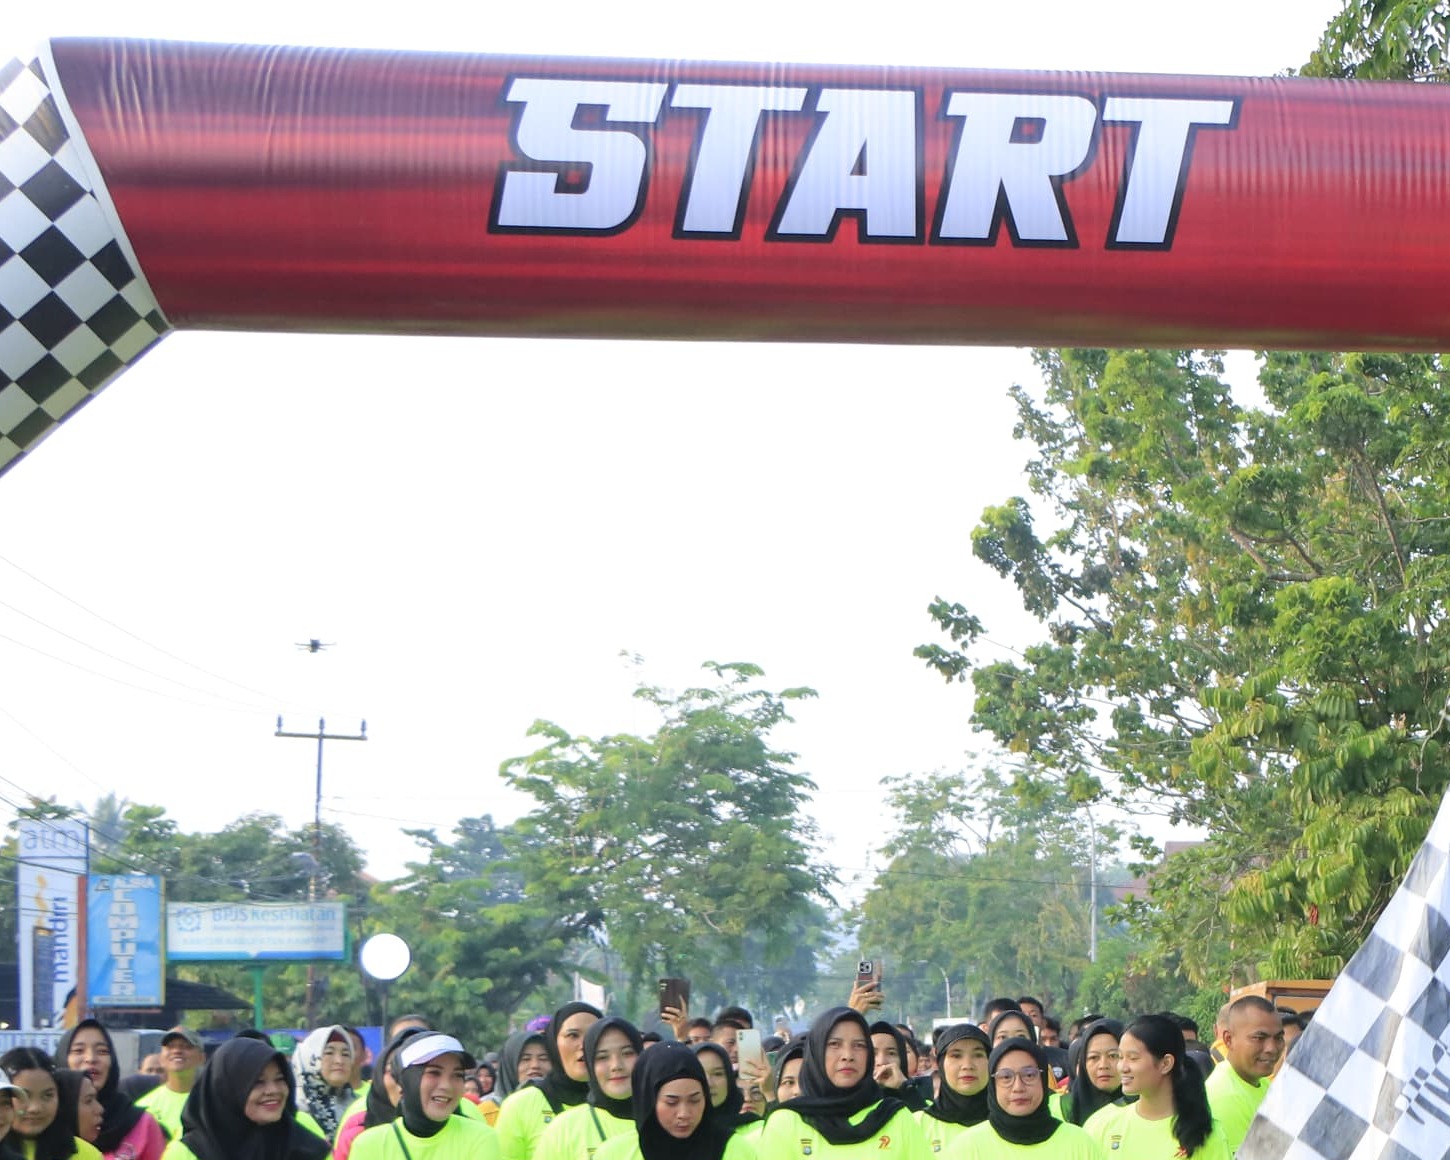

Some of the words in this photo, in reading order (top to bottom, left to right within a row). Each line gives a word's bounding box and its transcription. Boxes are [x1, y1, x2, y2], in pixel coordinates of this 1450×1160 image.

[490, 75, 1241, 249] START
[24, 828, 79, 850] atm
[47, 897, 69, 983] mandiri
[213, 908, 248, 921] BPJS
